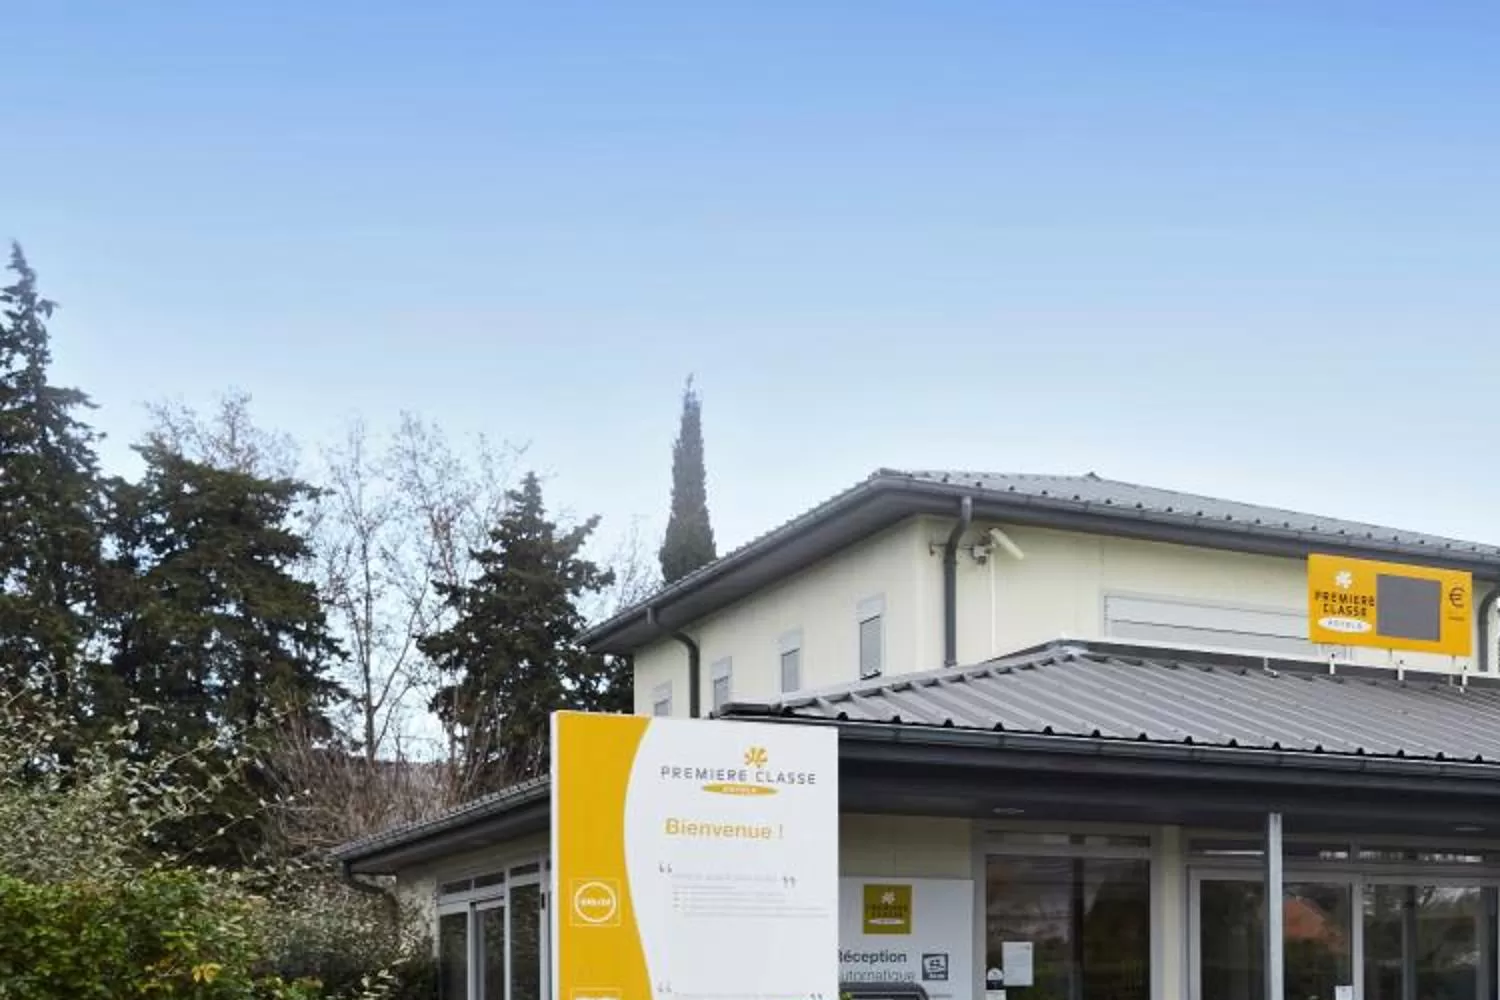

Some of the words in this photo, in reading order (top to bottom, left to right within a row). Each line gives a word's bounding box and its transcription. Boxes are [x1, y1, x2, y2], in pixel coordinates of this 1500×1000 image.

[1314, 591, 1376, 606] PREMIERE
[1322, 603, 1367, 617] CLASSE
[660, 766, 748, 781] PREMIERE
[755, 771, 817, 785] CLASSE
[665, 817, 772, 840] Bienvenue
[839, 949, 907, 965] éception
[840, 969, 916, 982] utomatique
